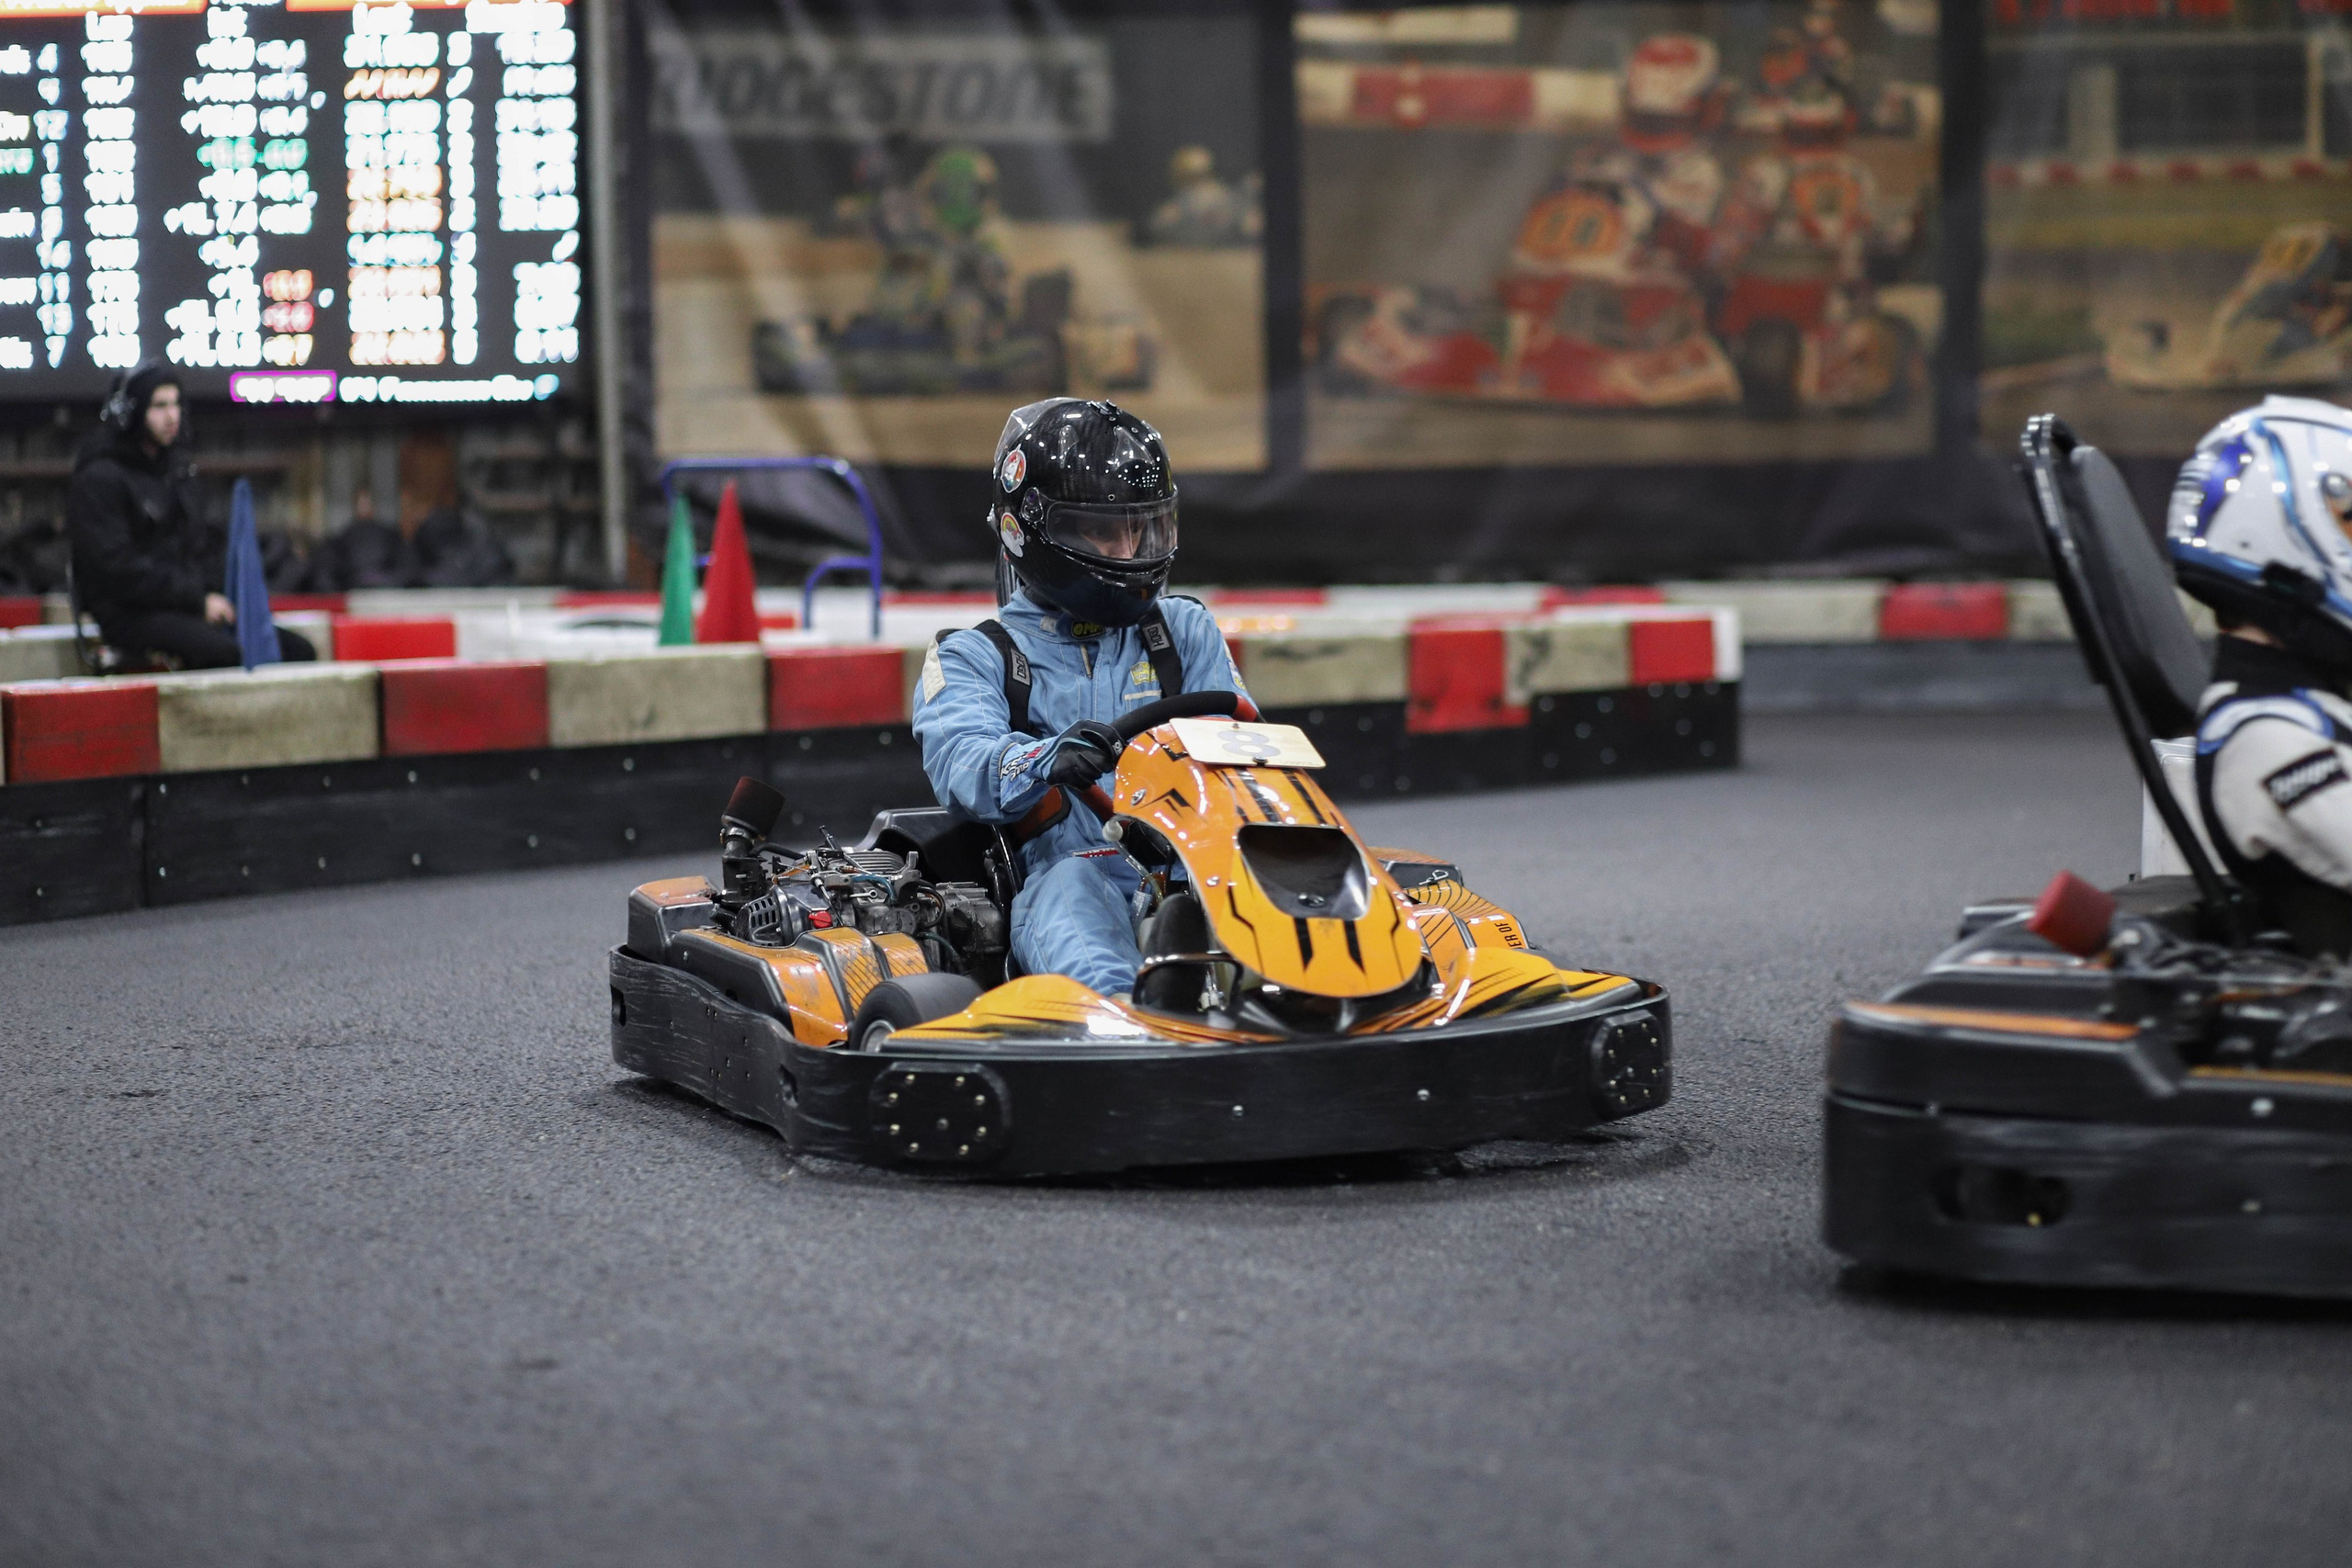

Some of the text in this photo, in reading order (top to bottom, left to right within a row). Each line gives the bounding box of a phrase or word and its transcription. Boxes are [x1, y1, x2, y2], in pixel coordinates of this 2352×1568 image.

[1216, 729, 1282, 758] 8
[1494, 921, 1523, 950] ER OF
